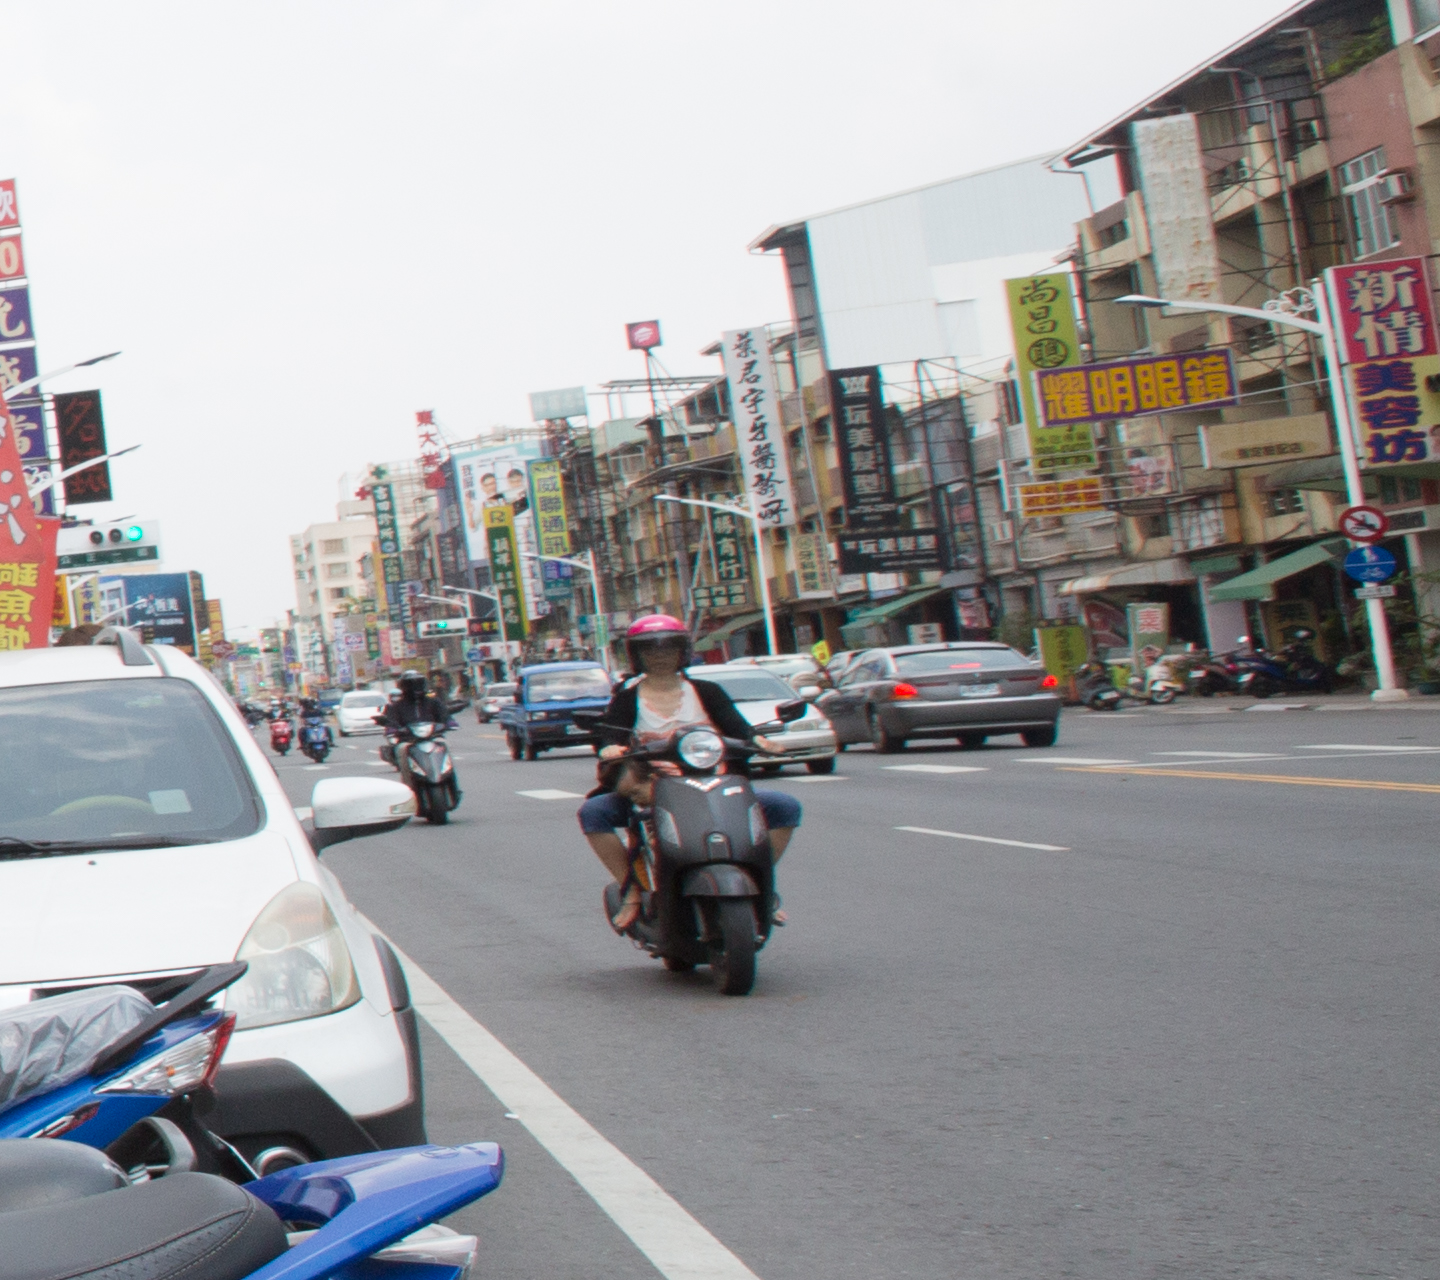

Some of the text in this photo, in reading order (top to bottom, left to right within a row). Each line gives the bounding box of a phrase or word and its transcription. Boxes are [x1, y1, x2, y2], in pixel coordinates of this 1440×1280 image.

[1042, 355, 1229, 420] 耀明眼鏡
[1353, 360, 1428, 464] 美容坊
